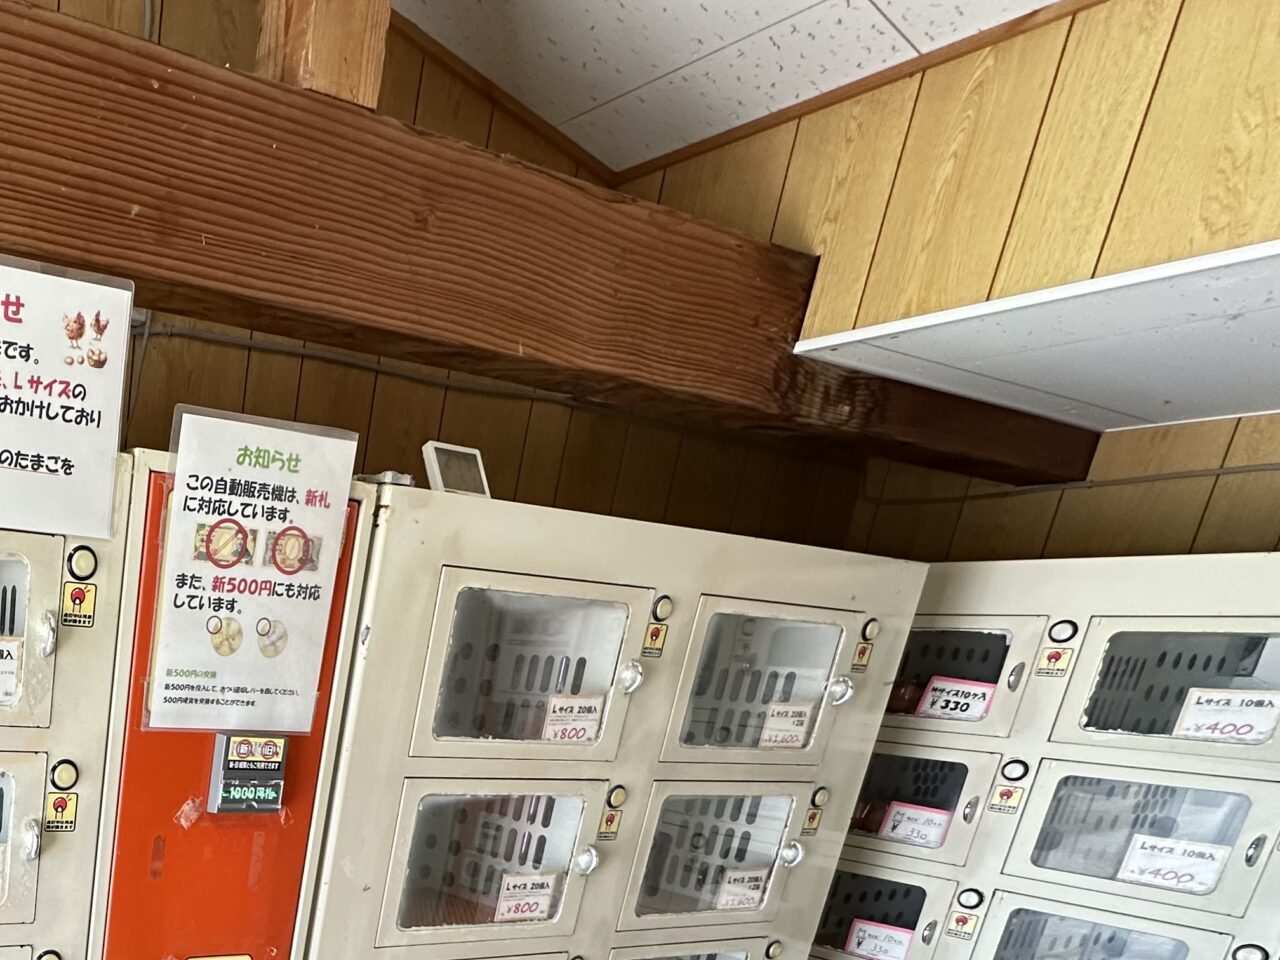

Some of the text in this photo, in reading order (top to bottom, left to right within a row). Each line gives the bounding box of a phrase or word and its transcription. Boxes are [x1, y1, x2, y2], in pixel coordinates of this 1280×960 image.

[236, 446, 301, 473] お知らせ
[183, 495, 294, 525] に対応しています。
[175, 573, 322, 601] また、新500円にも対応
[173, 593, 242, 614] しています。
[1195, 696, 1275, 708] Lサイズ 10個入
[1194, 722, 1254, 736] ¥400
[1140, 841, 1215, 861] Lサイズ 10個入
[1139, 867, 1195, 884] ¥400
